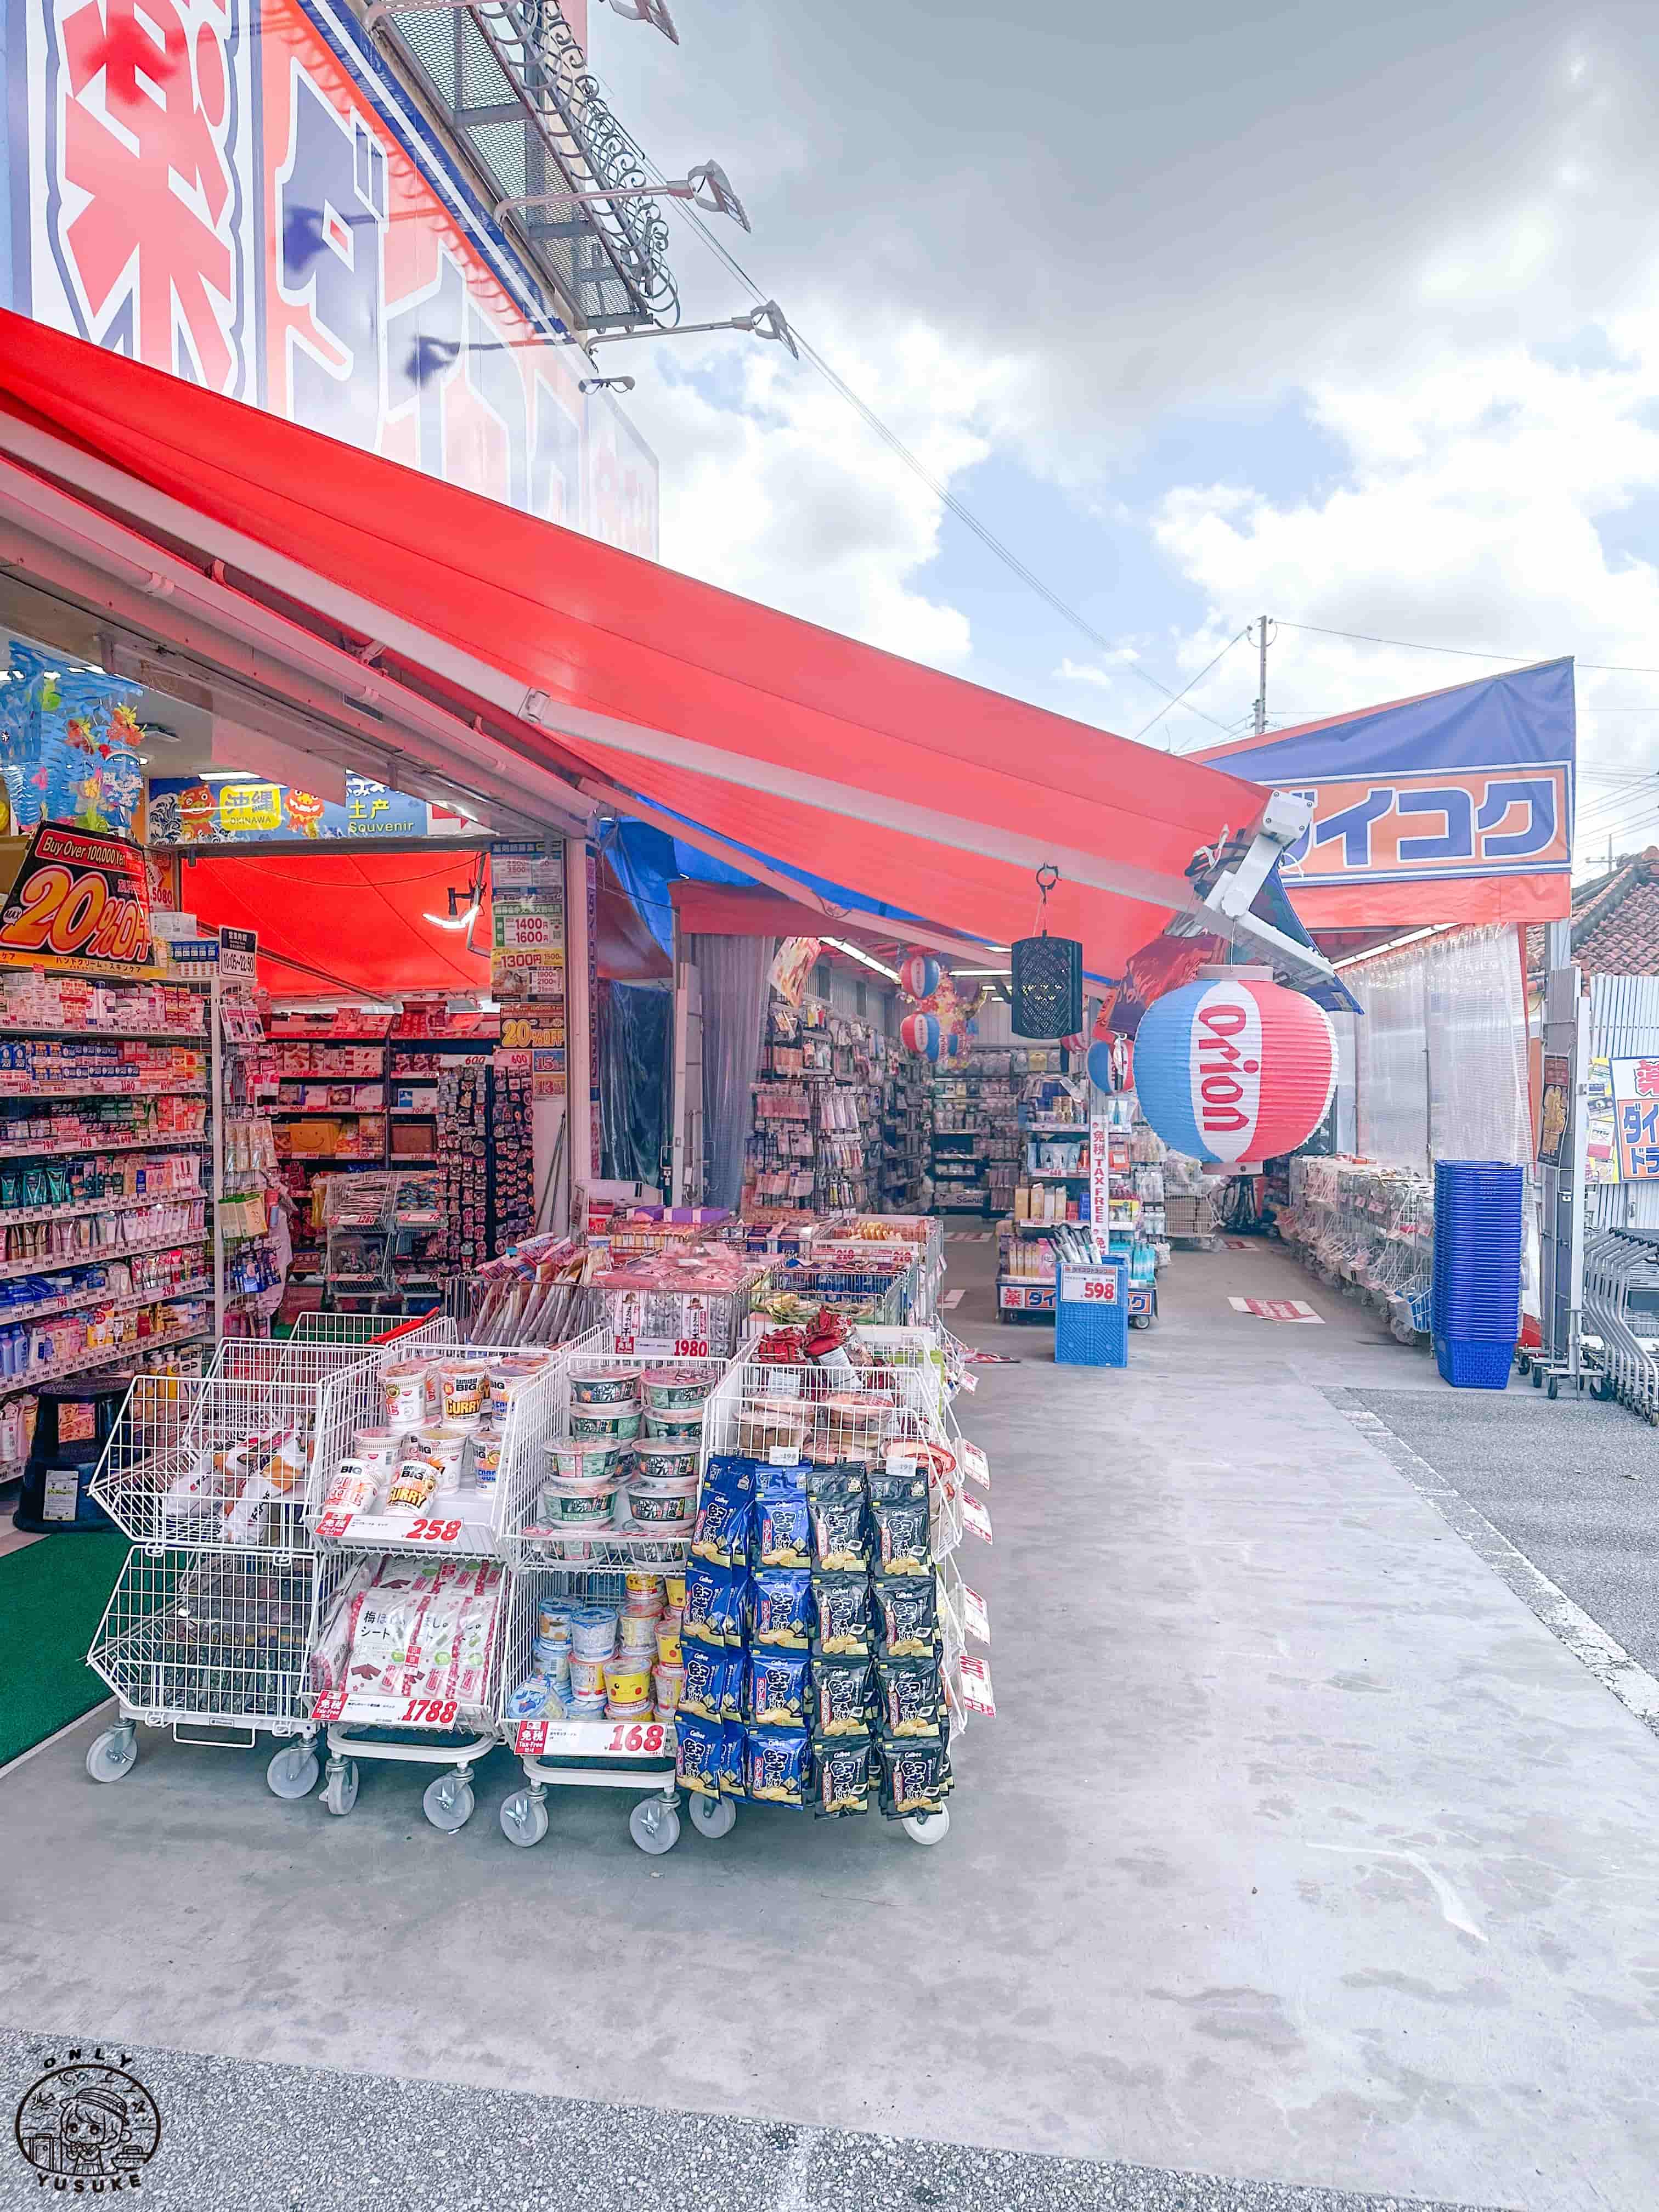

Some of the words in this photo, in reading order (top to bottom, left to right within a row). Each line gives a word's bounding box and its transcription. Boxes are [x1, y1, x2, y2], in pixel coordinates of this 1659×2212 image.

[348, 799, 390, 819] 土产
[230, 817, 272, 826] OKINAWA
[349, 821, 414, 833] Souvenir
[43, 837, 62, 854] Buy
[64, 840, 84, 857] Over
[4, 909, 21, 920] MAX
[511, 1054, 527, 1064] 600
[1093, 1159, 1105, 1185] TAX
[1094, 1188, 1104, 1223] FREE
[1005, 1288, 1021, 1306] 薬
[674, 1340, 707, 1357] 1980
[445, 1399, 480, 1415] CURRY
[340, 1466, 363, 1475] BIG
[401, 1470, 425, 1481] BIG
[387, 1487, 427, 1509] CURRY
[360, 1626, 390, 1640] シート
[319, 1699, 341, 1709] 免税
[521, 1729, 543, 1741] 免税
